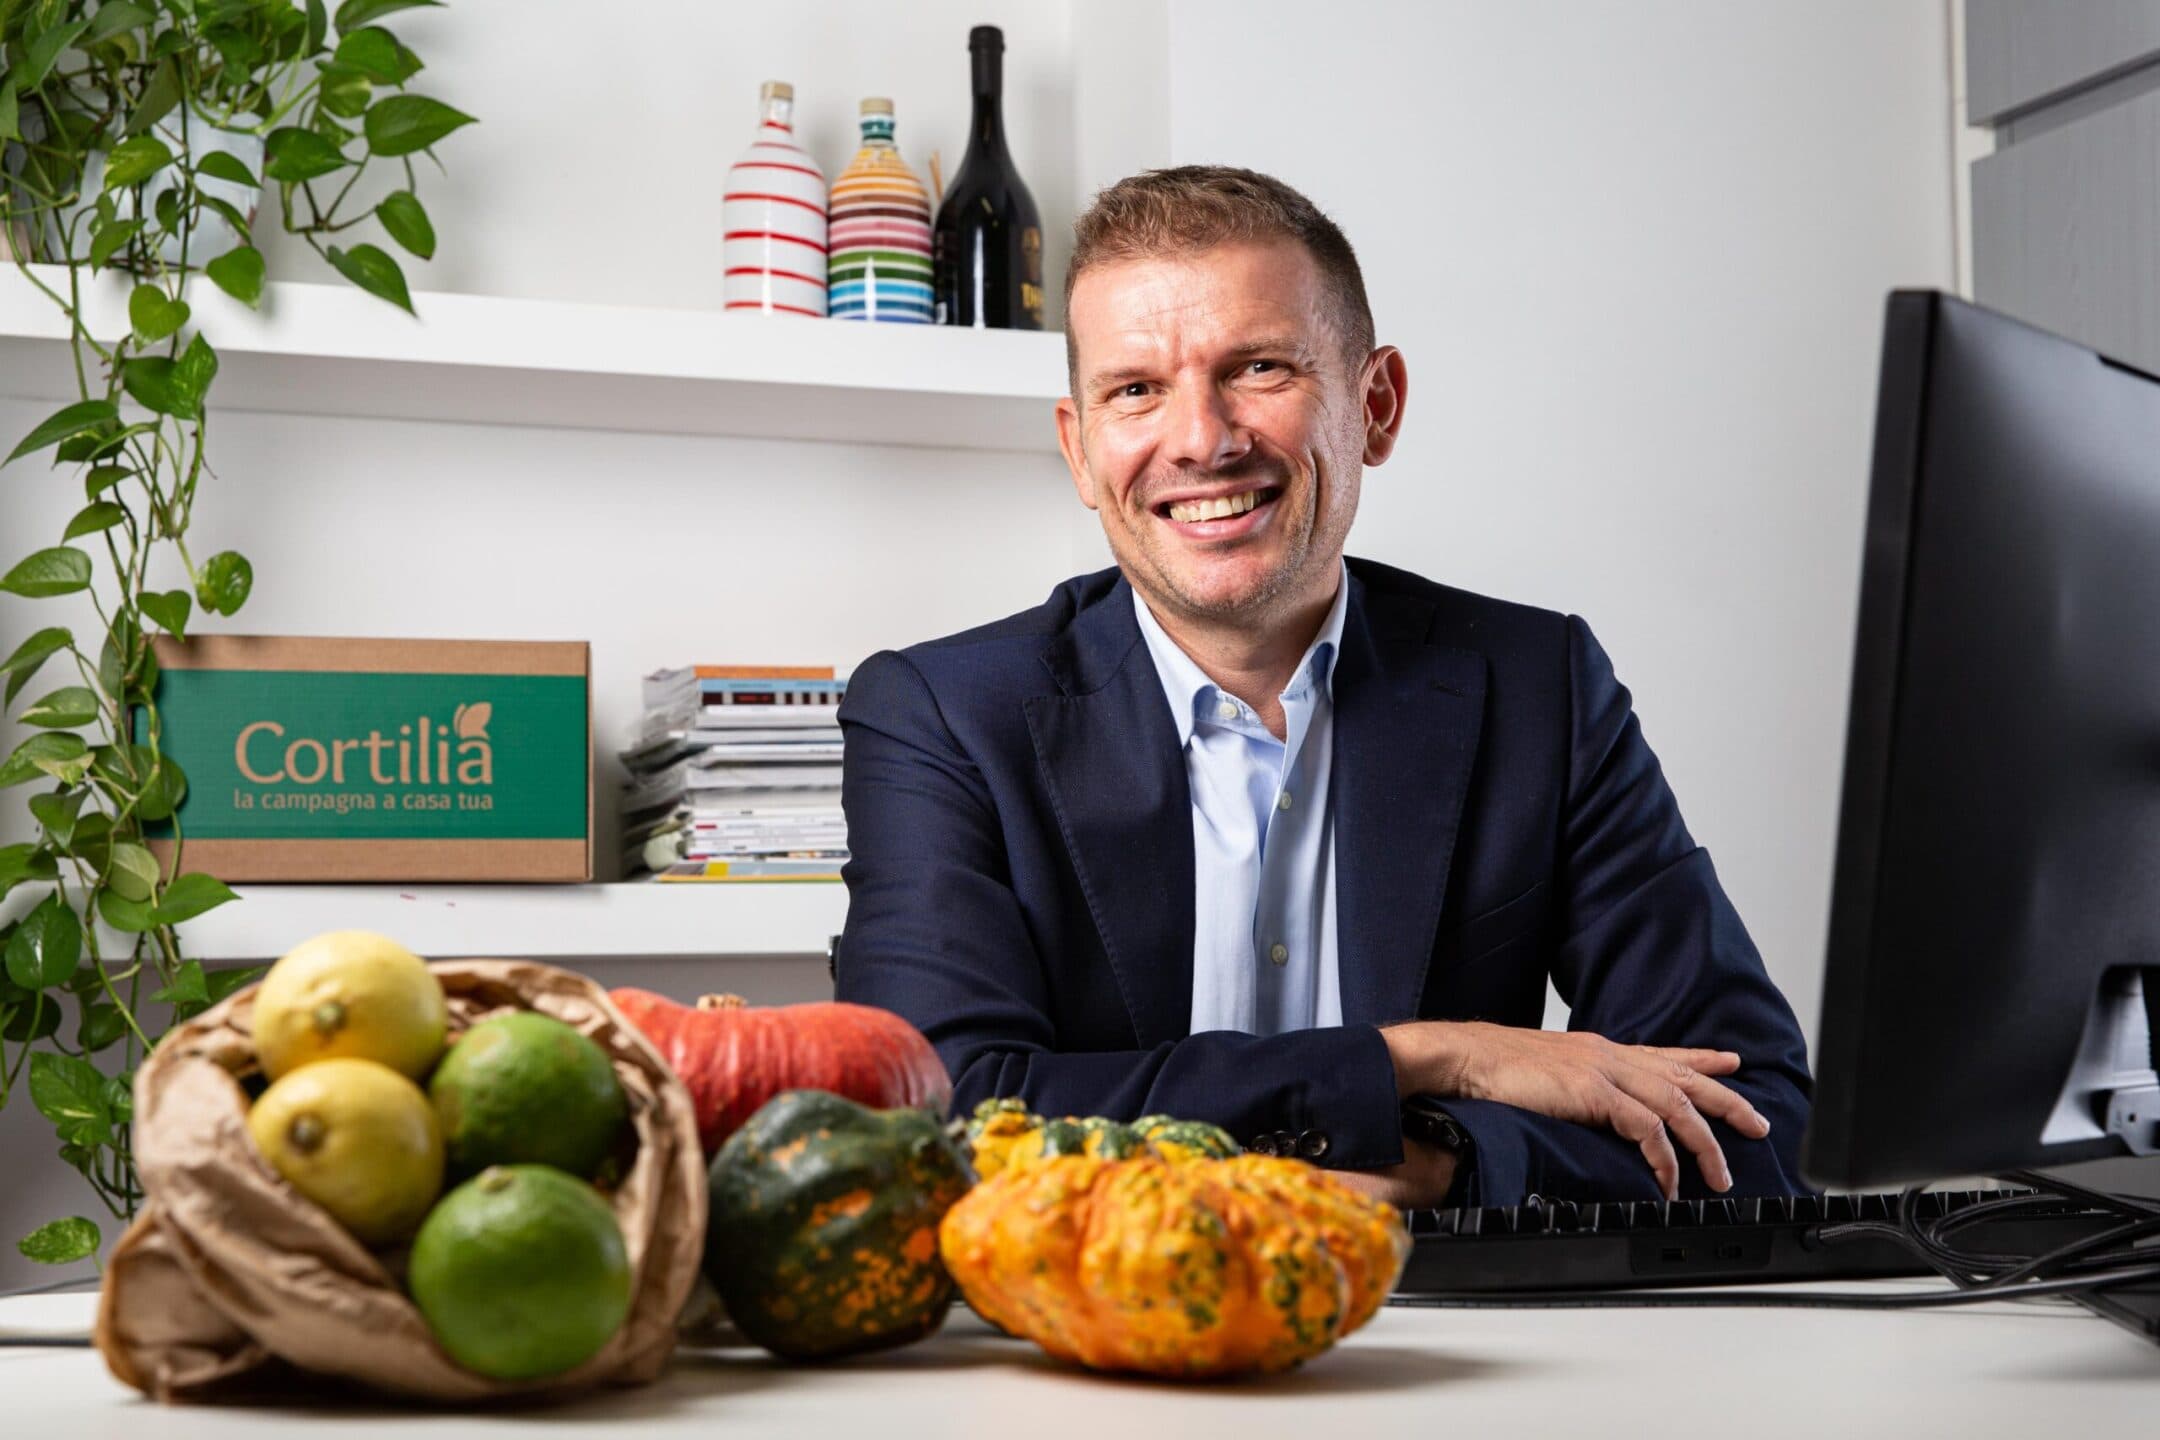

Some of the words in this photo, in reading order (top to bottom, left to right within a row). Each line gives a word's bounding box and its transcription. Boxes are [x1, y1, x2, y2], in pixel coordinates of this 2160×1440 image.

[234, 715, 494, 785] Cortilia
[233, 788, 254, 809] la
[261, 792, 376, 814] campagna
[382, 794, 396, 810] a
[402, 794, 452, 810] casa
[457, 791, 494, 810] tua
